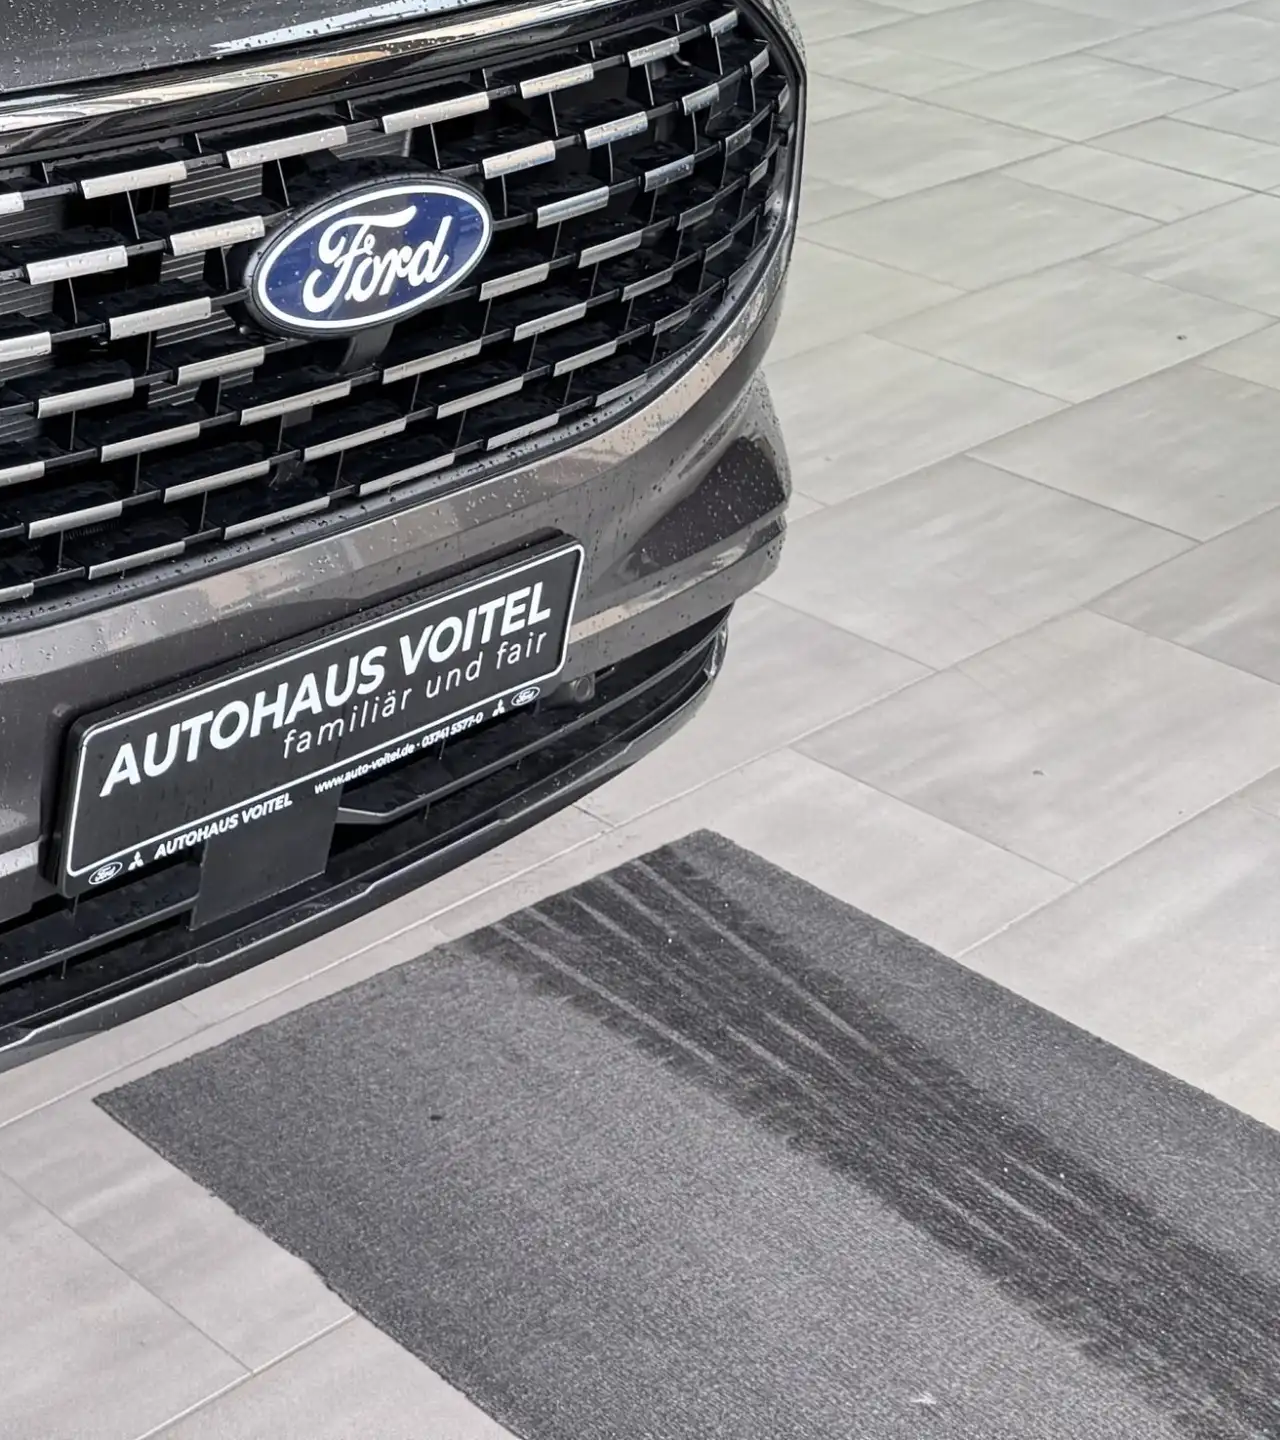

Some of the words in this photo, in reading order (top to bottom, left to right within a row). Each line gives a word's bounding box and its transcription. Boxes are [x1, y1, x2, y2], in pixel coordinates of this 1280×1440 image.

[302, 205, 453, 313] Ford
[99, 646, 388, 798] AUTOHAUS
[399, 581, 552, 676] VOITEL
[283, 686, 413, 760] familiär
[425, 651, 484, 700] und
[496, 631, 548, 670] fair
[153, 812, 239, 860] AUTOHAUS
[241, 792, 293, 824] VOITEL
[313, 742, 415, 795] www.auto-voitel.de
